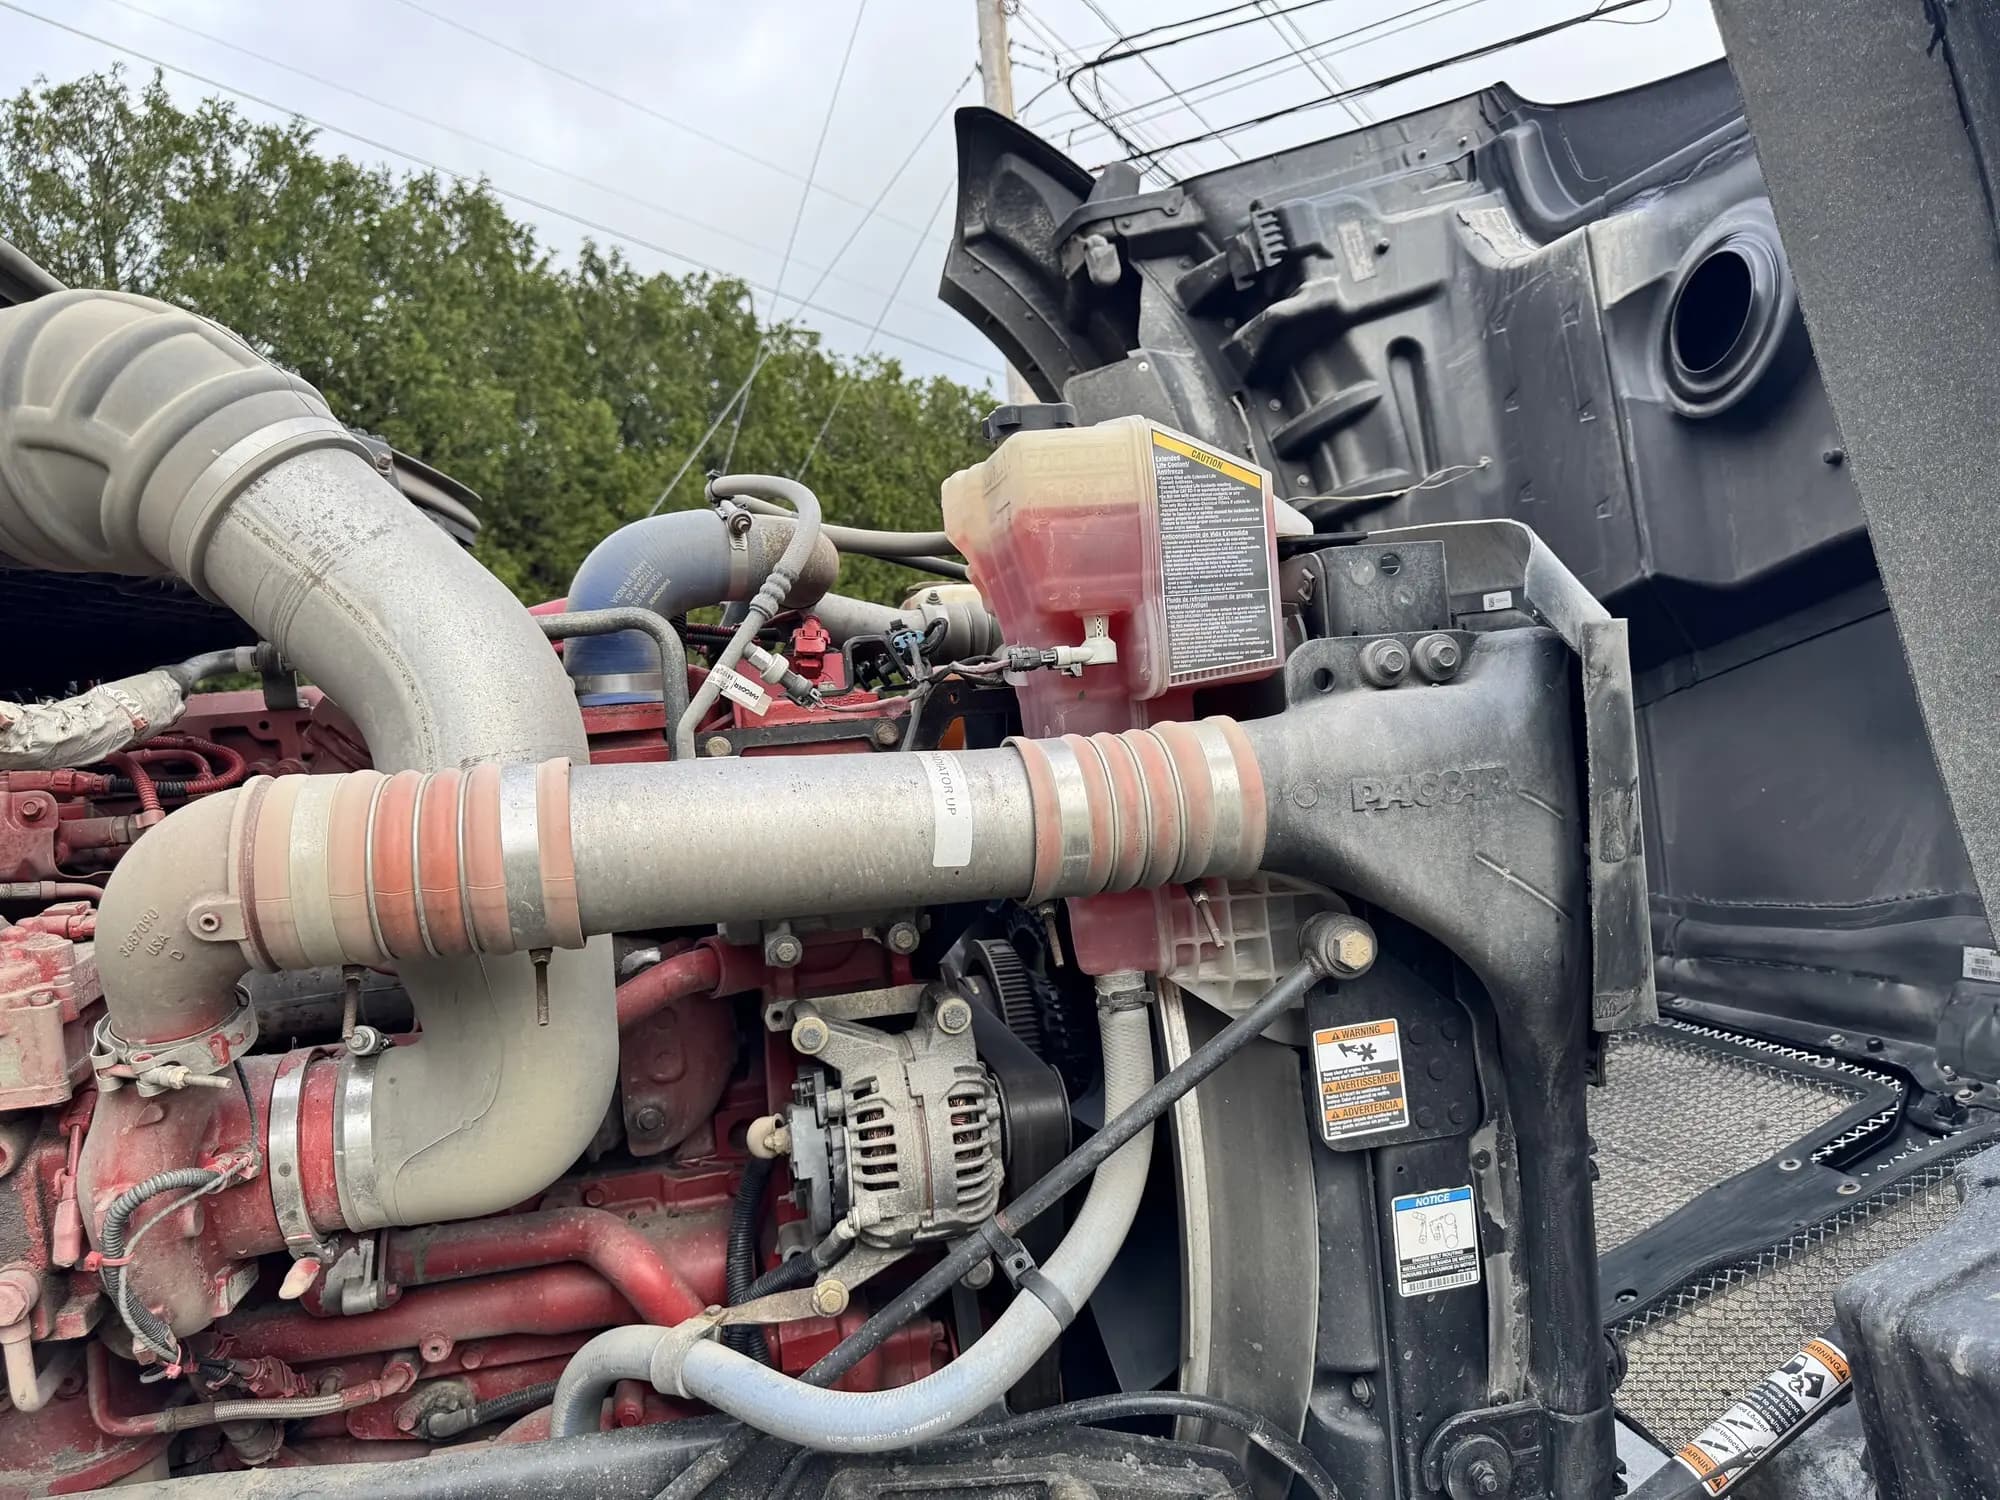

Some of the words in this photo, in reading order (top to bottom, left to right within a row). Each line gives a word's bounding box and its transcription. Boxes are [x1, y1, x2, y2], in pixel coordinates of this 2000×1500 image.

[1191, 449, 1224, 470] CAUTION
[945, 798, 957, 816] UP
[120, 908, 159, 958] 3687090
[145, 934, 172, 957] USA
[169, 949, 185, 960] D
[1341, 1025, 1380, 1039] WARNING
[1336, 1073, 1398, 1091] AVERTISSEMENT
[1343, 1100, 1399, 1117] ADVERTENCIA
[1416, 1193, 1450, 1207] NOTICE
[1779, 1402, 1792, 1417] lock
[1747, 1411, 1769, 1432] Locked
[1720, 1430, 1742, 1452] Unlocke
[1685, 1448, 1712, 1473] ARNIN
